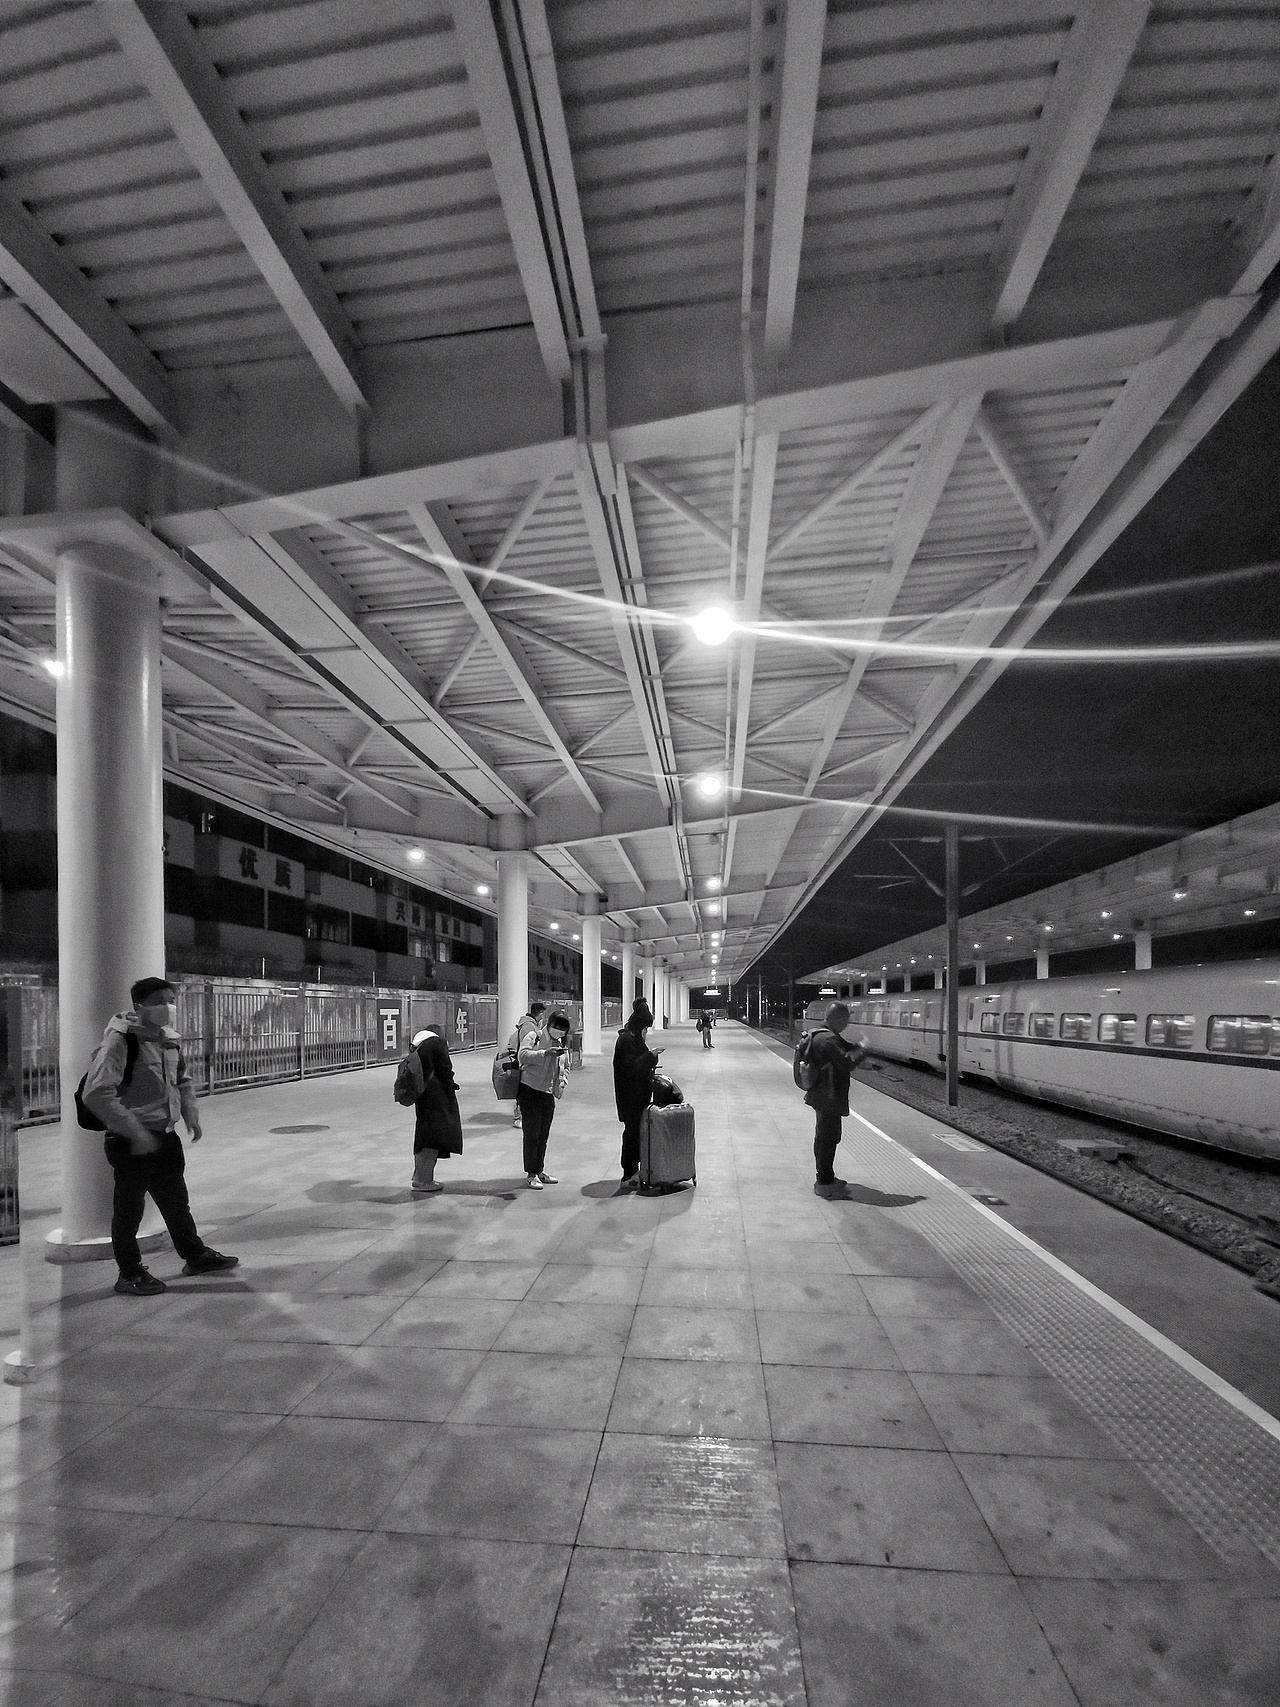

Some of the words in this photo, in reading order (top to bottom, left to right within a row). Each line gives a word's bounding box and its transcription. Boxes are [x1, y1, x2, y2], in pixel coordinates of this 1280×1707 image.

[239, 846, 292, 890] 优质
[379, 1008, 400, 1050] 百
[455, 1007, 468, 1042] 年
